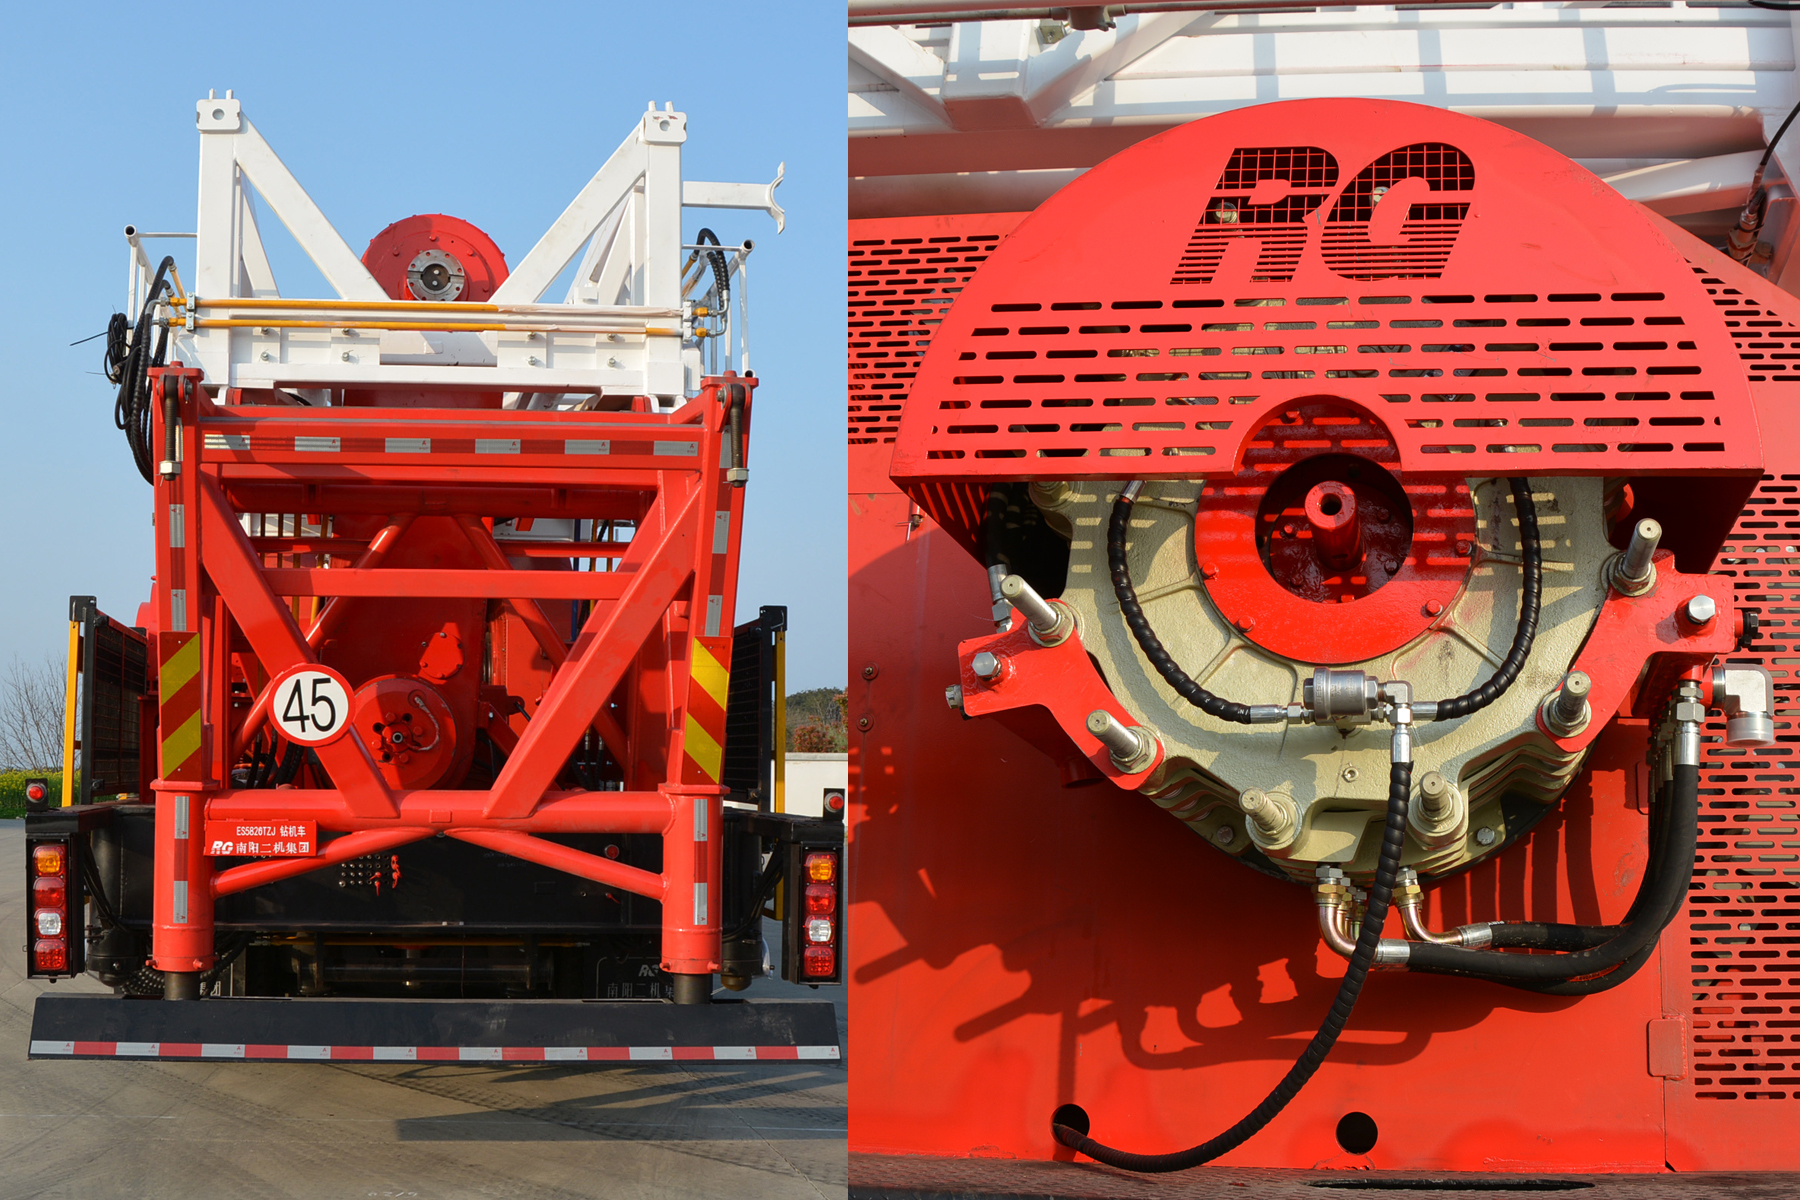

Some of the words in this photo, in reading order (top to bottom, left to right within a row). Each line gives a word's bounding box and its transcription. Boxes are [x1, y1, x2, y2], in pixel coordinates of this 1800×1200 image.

[1169, 142, 1475, 284] RG
[282, 678, 336, 732] 45
[210, 841, 234, 854] RG
[236, 842, 310, 854] 南阳二机集团
[280, 825, 306, 837] 钻机车
